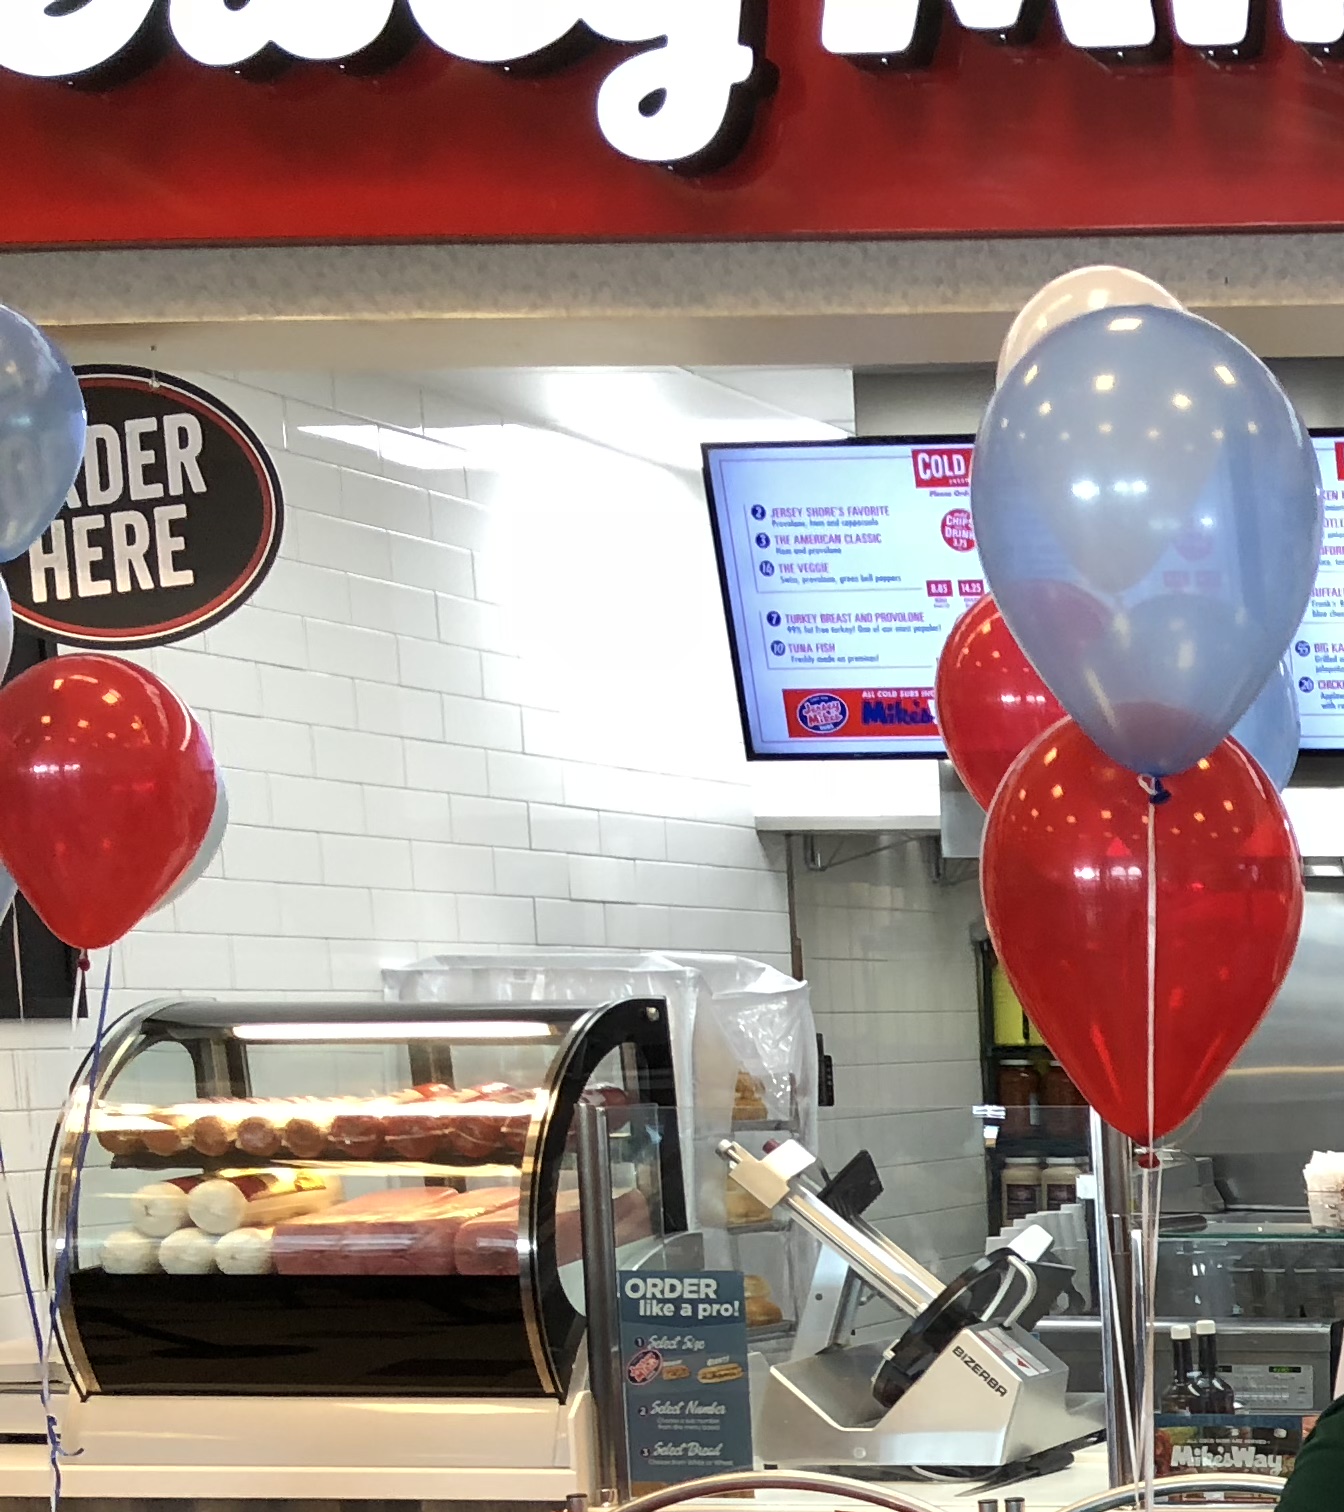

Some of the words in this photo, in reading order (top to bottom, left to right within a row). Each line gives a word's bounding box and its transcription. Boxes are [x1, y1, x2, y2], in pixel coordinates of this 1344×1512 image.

[64, 412, 207, 509] DER
[917, 452, 966, 480] COLD
[772, 507, 802, 518] JERSEY
[847, 505, 890, 517] FAVORITE
[774, 535, 790, 545] THE
[794, 534, 842, 545] AMERICAN
[844, 533, 882, 544] CLASSIC
[29, 503, 194, 603] HERE
[778, 563, 794, 573] THE
[786, 614, 817, 624] TURKEY
[855, 613, 873, 623] AND
[875, 612, 924, 623] PROVOLONE
[816, 643, 835, 653] FISH
[625, 1278, 718, 1300] ORDER
[639, 1300, 675, 1317] like
[680, 1304, 692, 1316] a
[698, 1300, 740, 1320] pro!
[647, 1335, 680, 1350] Select
[952, 1346, 1008, 1397] BIZERBA
[650, 1400, 684, 1415] Select
[686, 1401, 727, 1415] Number
[653, 1442, 685, 1457] Select
[684, 1442, 722, 1457] Bread
[1231, 1445, 1283, 1476] Way
